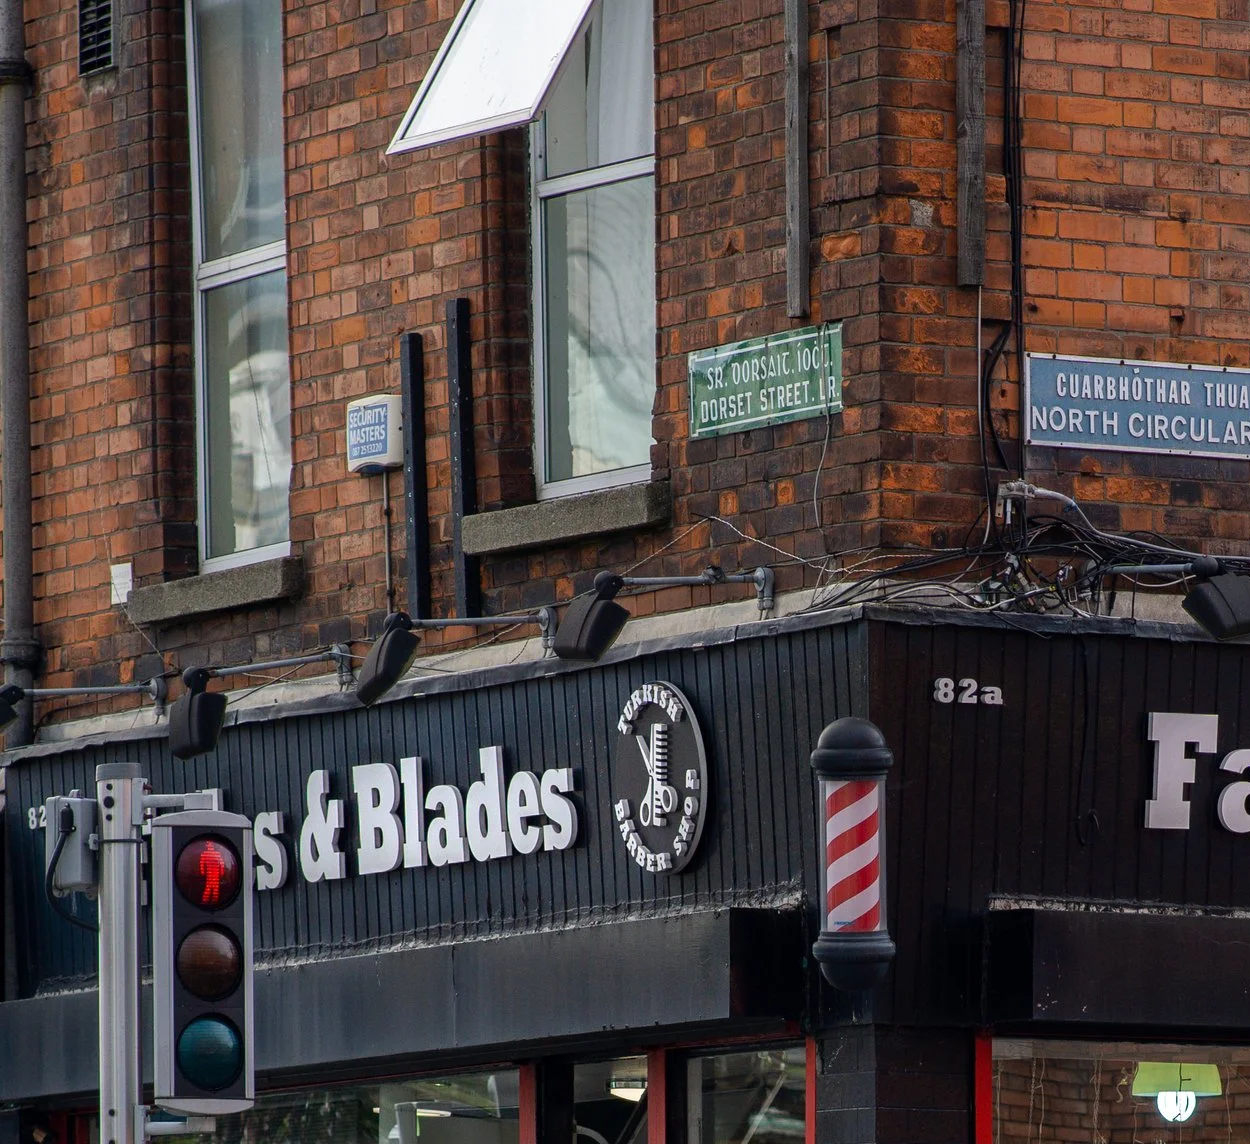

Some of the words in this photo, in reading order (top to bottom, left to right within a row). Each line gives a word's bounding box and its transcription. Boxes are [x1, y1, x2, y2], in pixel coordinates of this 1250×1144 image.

[707, 366, 728, 390] SR.
[1056, 368, 1191, 405] CUARBHÓTHAR
[701, 391, 752, 424] DORSET
[1031, 406, 1118, 436] NORTH
[349, 424, 385, 447] MASTERS
[934, 677, 1003, 705] 82a
[618, 683, 684, 735] TURKISH
[300, 769, 346, 883] &
[353, 746, 577, 875] Blades
[615, 798, 673, 873] BARBER
[673, 769, 700, 857] SHOP
